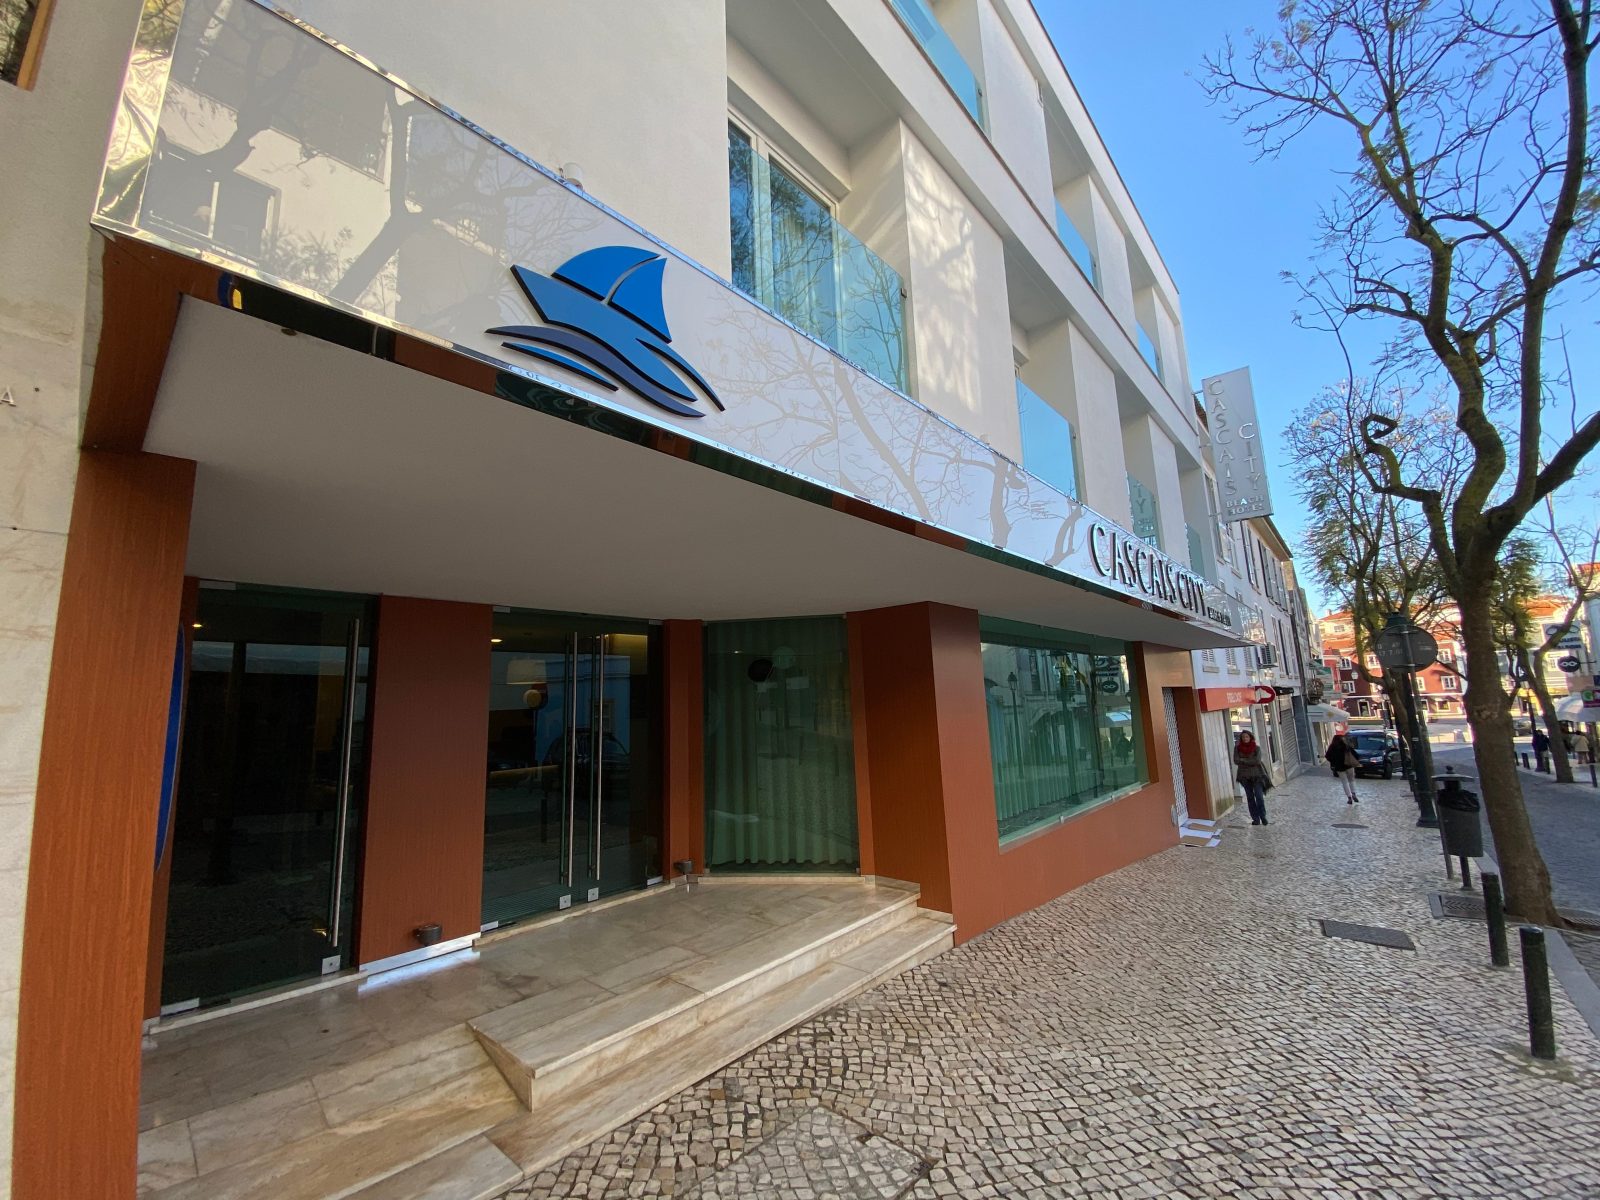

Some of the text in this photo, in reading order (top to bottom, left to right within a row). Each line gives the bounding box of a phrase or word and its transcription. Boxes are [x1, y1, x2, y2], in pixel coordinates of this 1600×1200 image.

[1207, 379, 1237, 496] CASCAIS
[1238, 422, 1262, 491] CITY
[1226, 495, 1264, 508] BEACH
